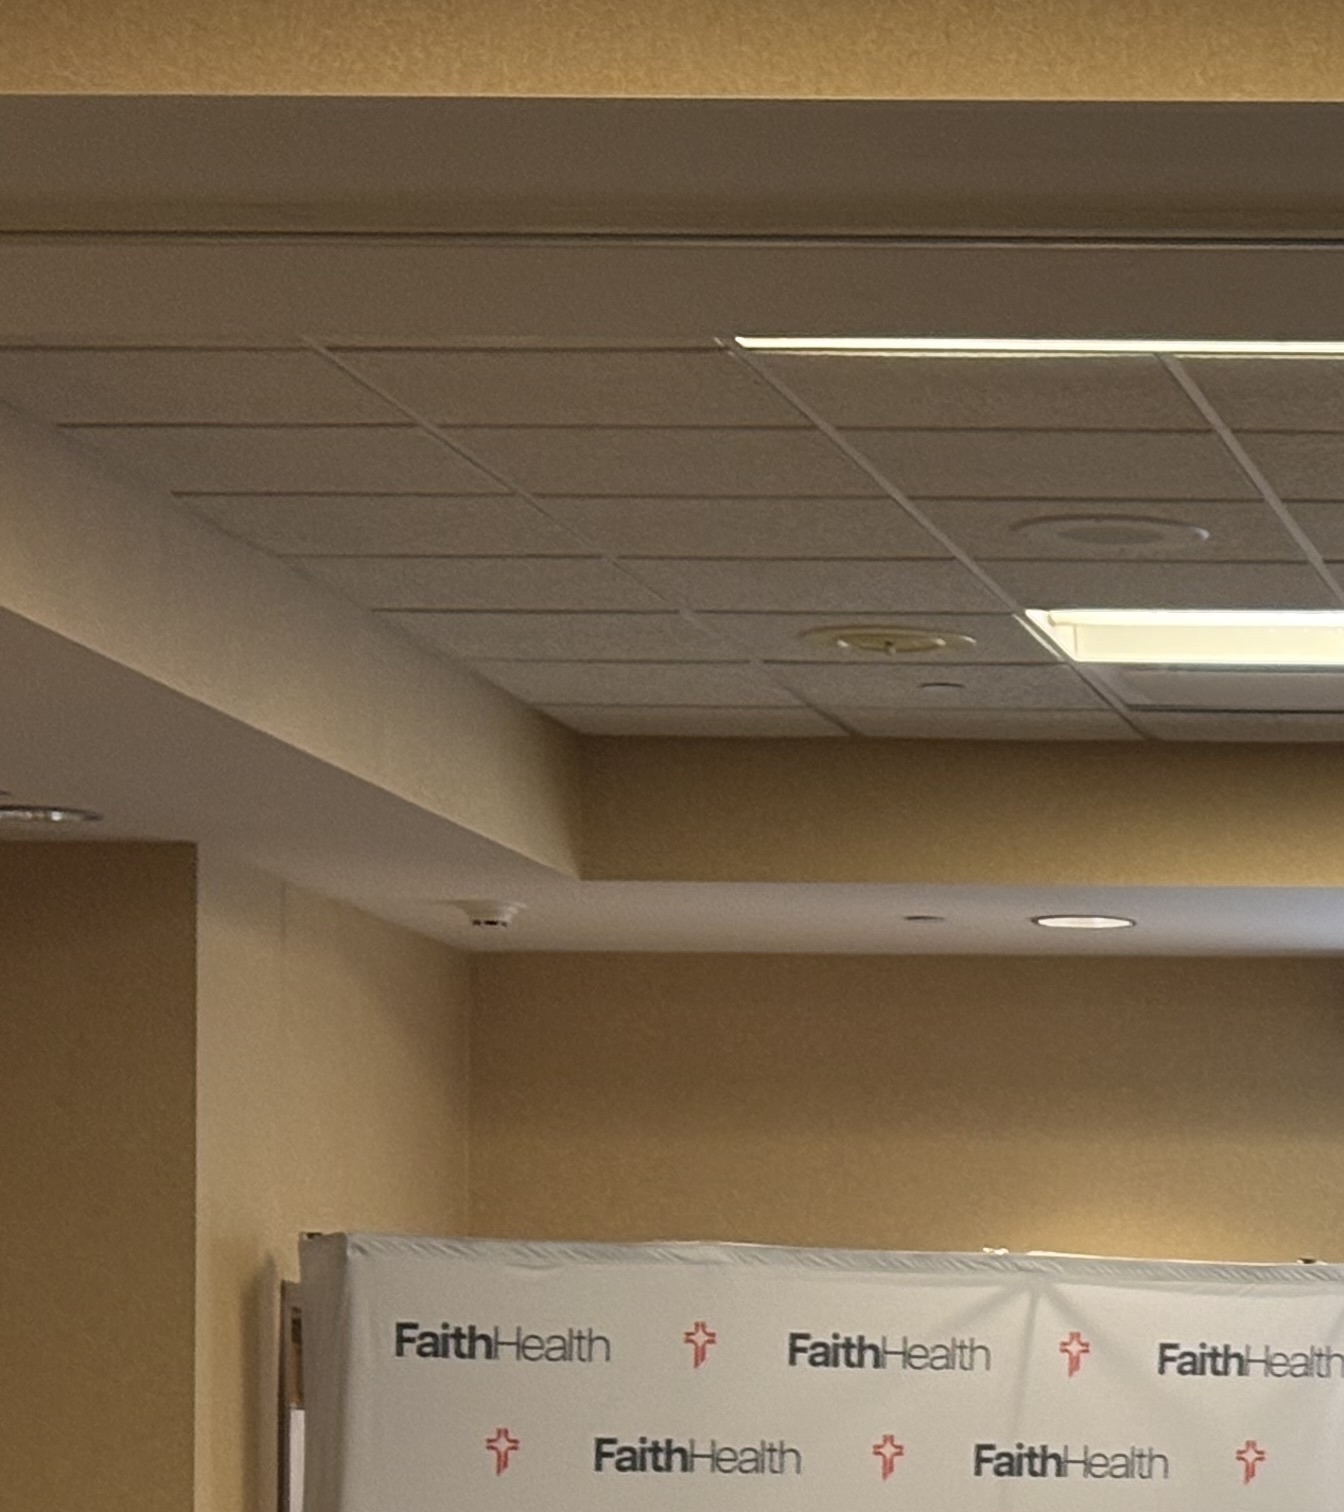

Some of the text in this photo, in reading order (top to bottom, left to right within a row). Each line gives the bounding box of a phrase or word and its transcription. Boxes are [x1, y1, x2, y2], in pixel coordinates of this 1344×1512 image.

[394, 1321, 610, 1363] FaithHealth
[788, 1331, 991, 1372] FaithHealth
[594, 1436, 801, 1475] FaithHealth
[973, 1442, 1169, 1480] FaithHealth
